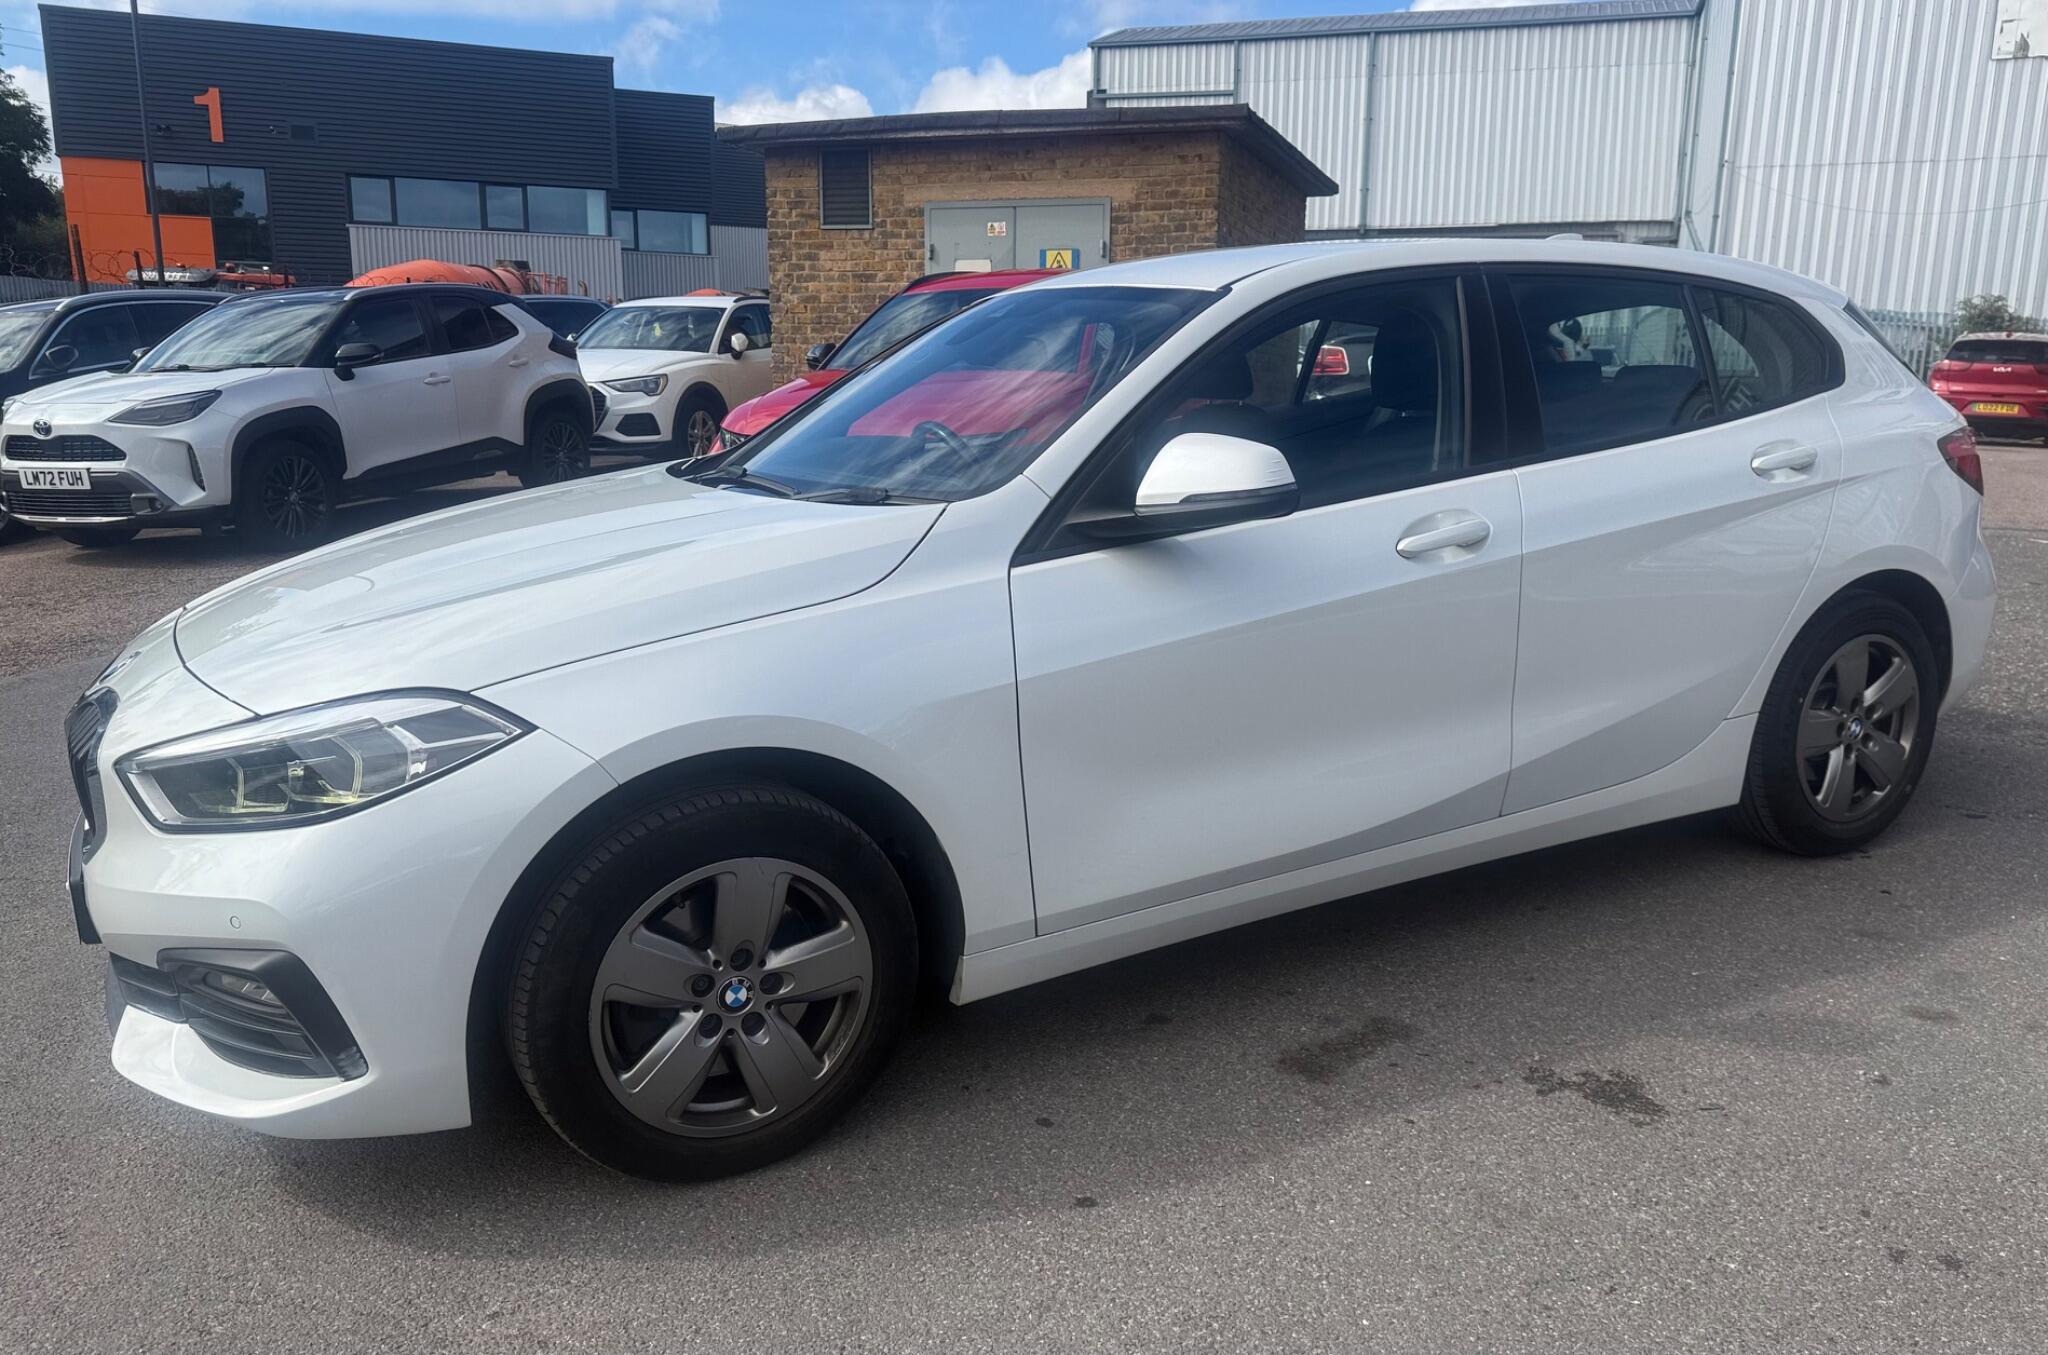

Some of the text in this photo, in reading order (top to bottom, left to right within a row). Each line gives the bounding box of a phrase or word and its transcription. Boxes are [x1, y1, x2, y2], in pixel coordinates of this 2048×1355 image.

[194, 87, 224, 142] 1
[23, 471, 84, 486] LM72 FUH
